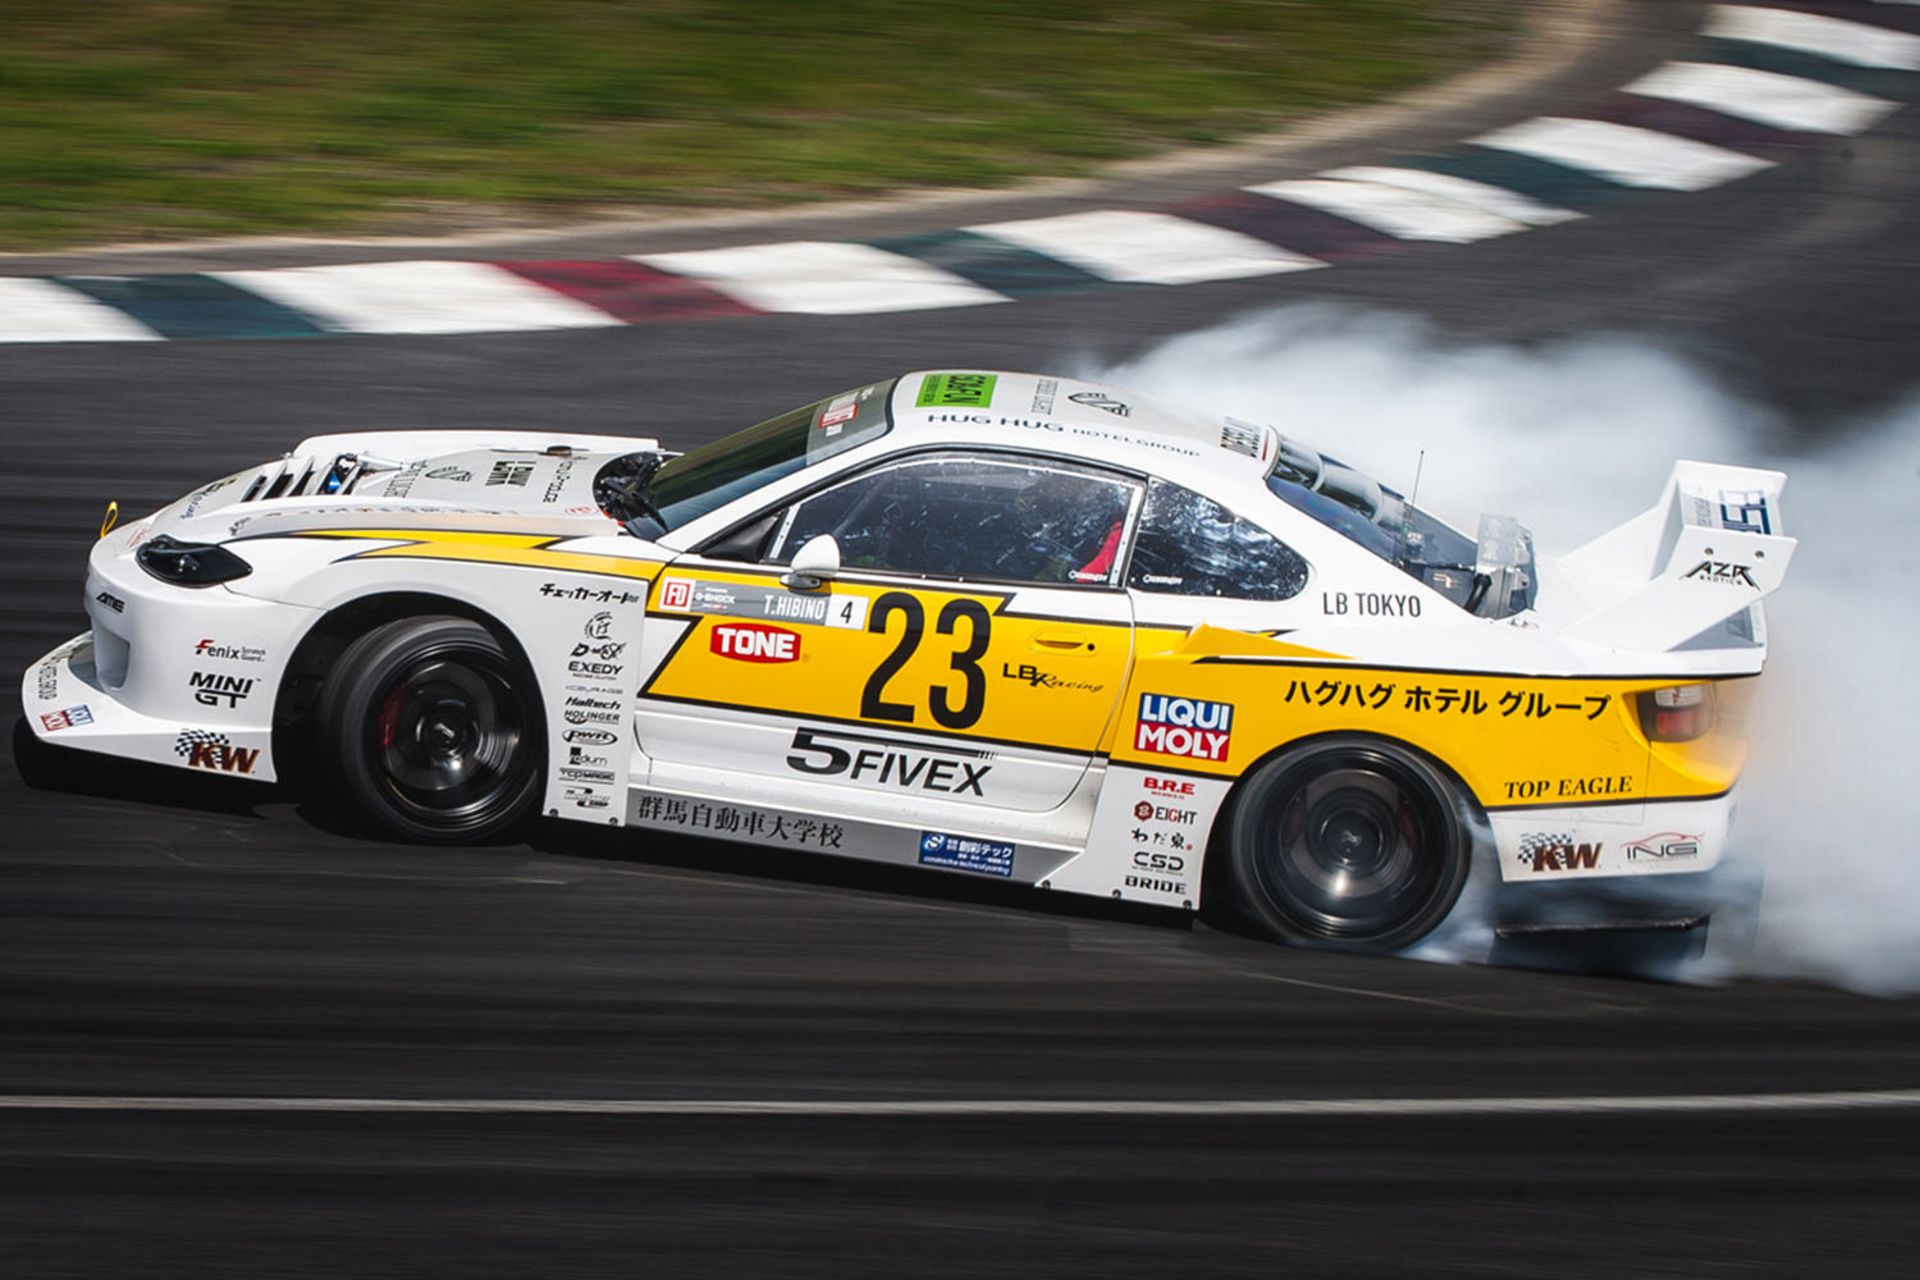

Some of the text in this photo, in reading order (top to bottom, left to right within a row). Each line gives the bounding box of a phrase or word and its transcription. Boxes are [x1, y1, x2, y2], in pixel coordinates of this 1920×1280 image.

[928, 413, 991, 425] HUG
[1000, 417, 1064, 432] HUG
[763, 594, 853, 624] T.HIBINO 4
[1322, 592, 1422, 618] LB TOKYO
[194, 639, 240, 660] Fenix
[716, 627, 796, 660] TONE
[567, 661, 623, 675] EXEDY
[859, 591, 992, 730] 23
[189, 671, 254, 694] MINI
[194, 689, 247, 709] GT
[564, 696, 621, 710] Haltech
[1284, 680, 1612, 721] ハグハグ ホテル グループ
[563, 710, 621, 721] HOLINGER
[1141, 694, 1231, 731] LIQUI
[1137, 723, 1230, 760] MOLY
[1143, 776, 1196, 796] B.R.E
[1504, 776, 1633, 800] TOP EAGLE
[637, 795, 845, 849] 群馬自動車大学校
[1154, 806, 1198, 825] EIGHT
[1134, 852, 1184, 869] CSD
[1532, 842, 1604, 872] KW
[1626, 842, 1698, 860] ING
[1124, 874, 1188, 895] BRIDE
